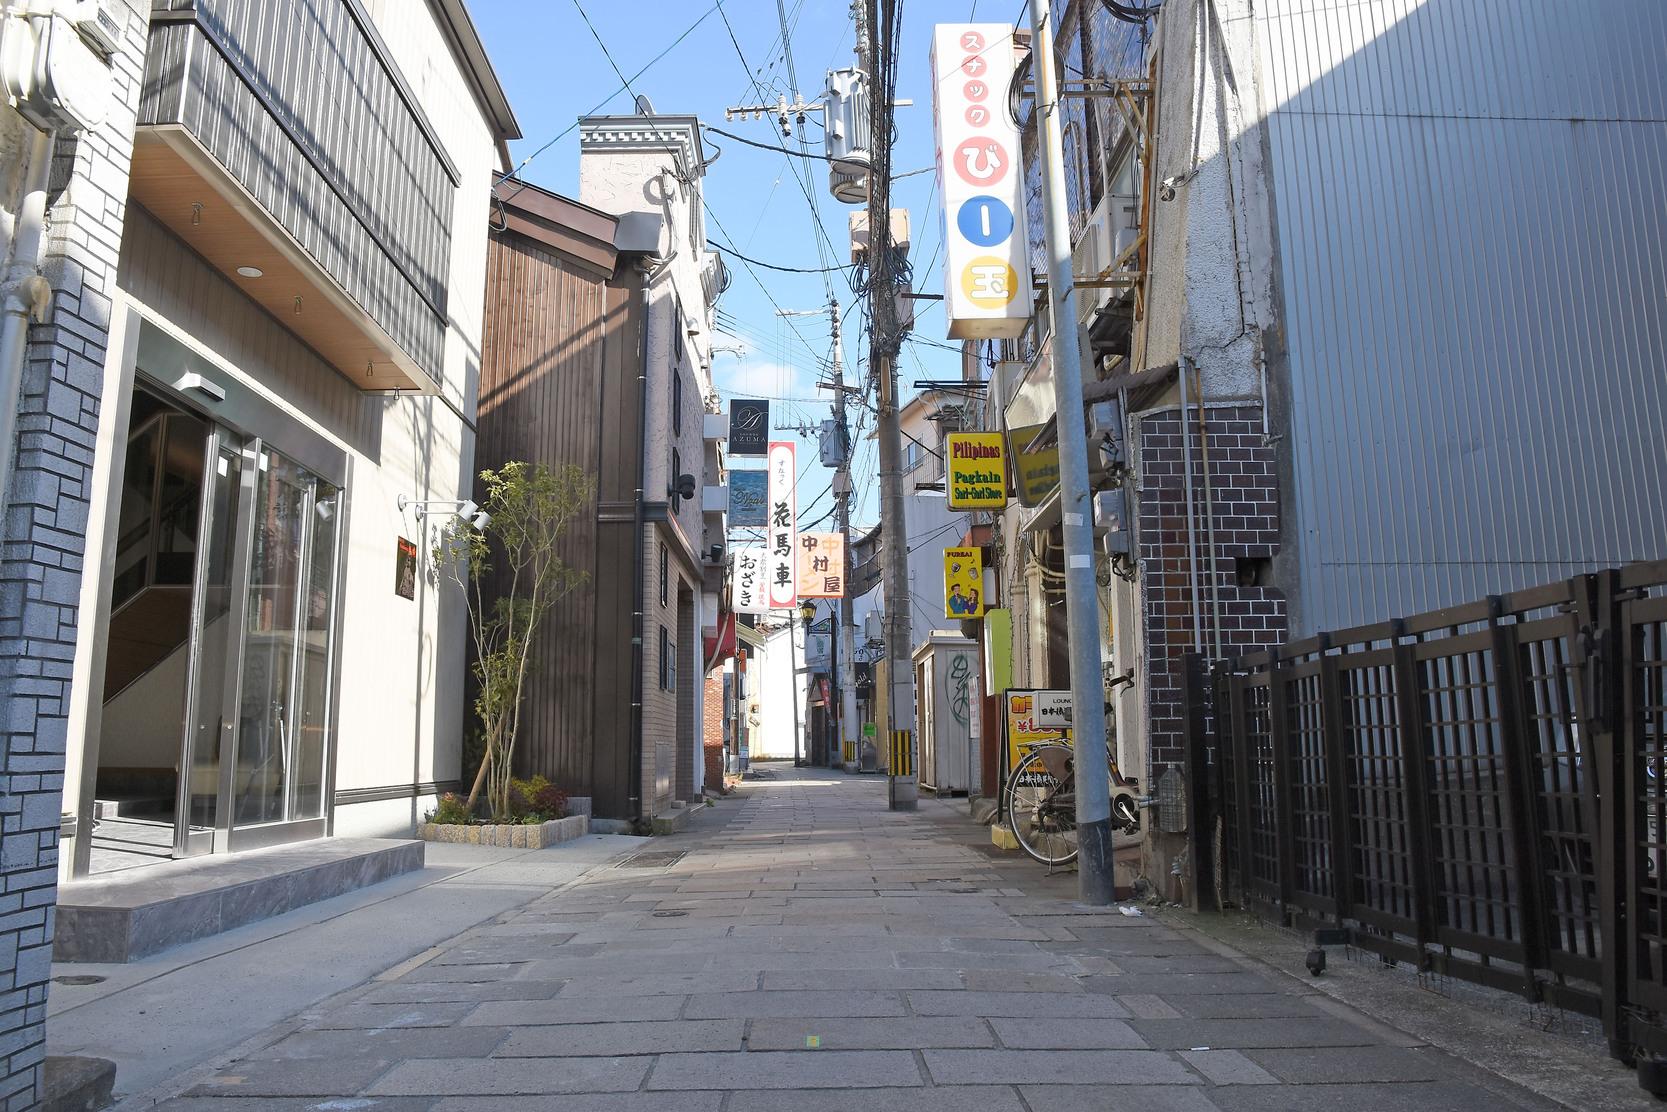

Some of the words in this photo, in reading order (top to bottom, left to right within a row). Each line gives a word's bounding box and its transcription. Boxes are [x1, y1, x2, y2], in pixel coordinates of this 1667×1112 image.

[963, 34, 986, 124] スナック
[952, 441, 1001, 461] Pilipinas
[953, 470, 1002, 485] Pagkain
[985, 486, 1003, 500] Store
[772, 501, 793, 588] 花馬車
[801, 535, 842, 593] 中村屋
[739, 554, 758, 608] おざき
